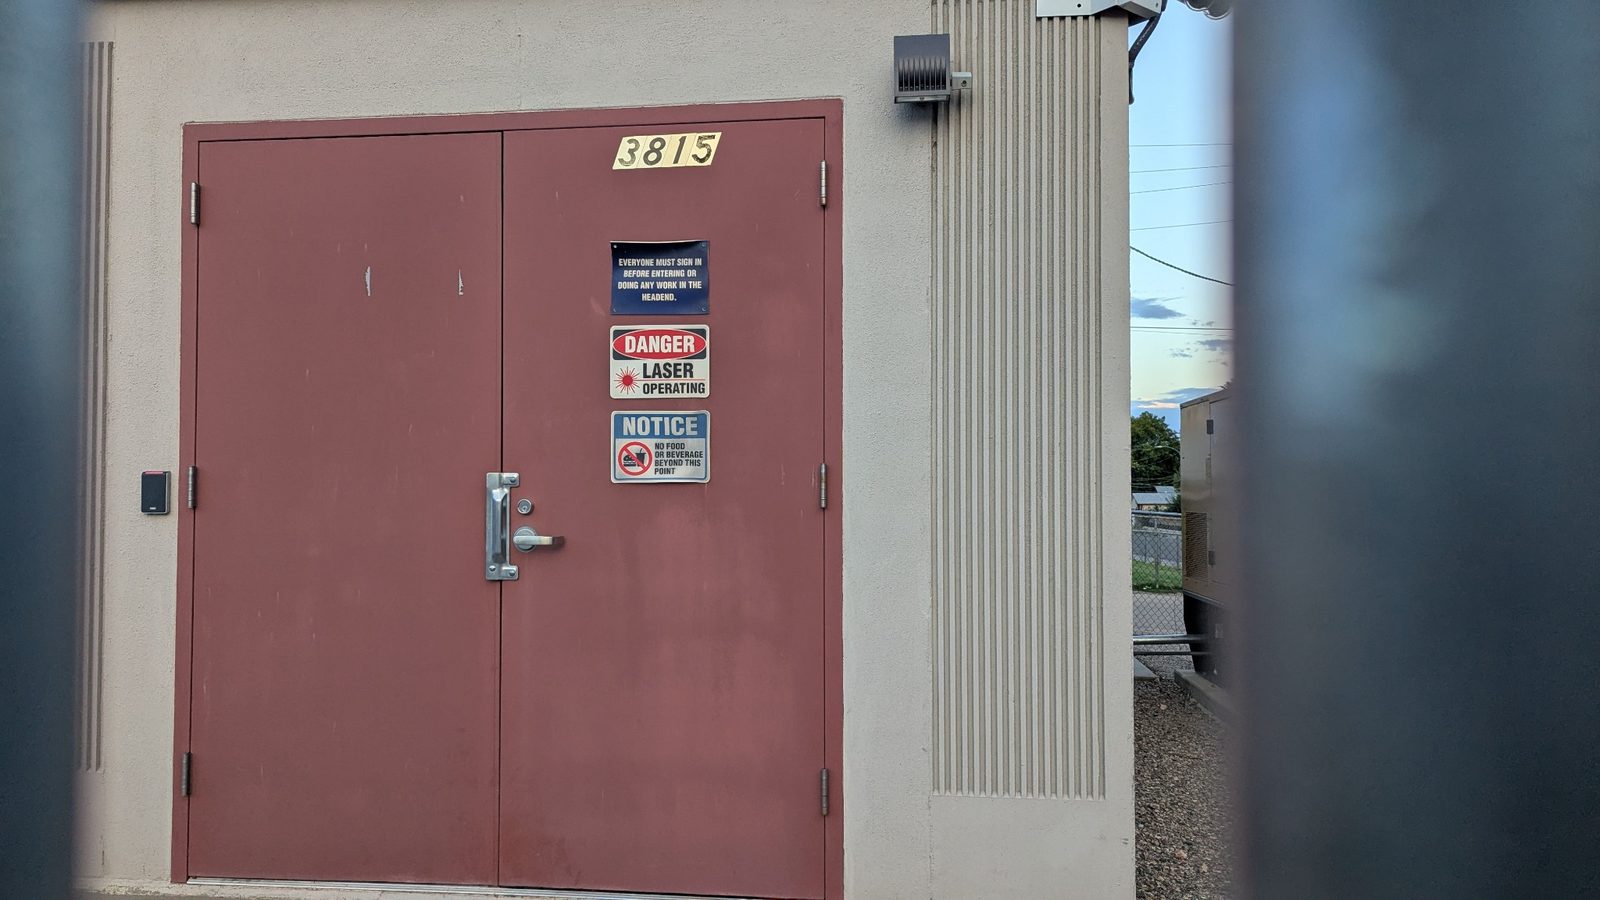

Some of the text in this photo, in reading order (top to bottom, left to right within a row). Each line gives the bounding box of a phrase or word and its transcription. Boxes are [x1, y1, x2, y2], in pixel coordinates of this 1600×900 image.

[618, 135, 715, 166] 3815
[656, 258, 675, 266] MUST
[677, 258, 693, 266] SIGN
[695, 258, 702, 266] IN
[656, 281, 677, 289] WORK
[679, 281, 686, 289] IN
[625, 335, 695, 353] DANGER
[643, 363, 693, 378] LASER
[643, 383, 705, 394] OPERATING
[623, 416, 698, 436] NOTICE
